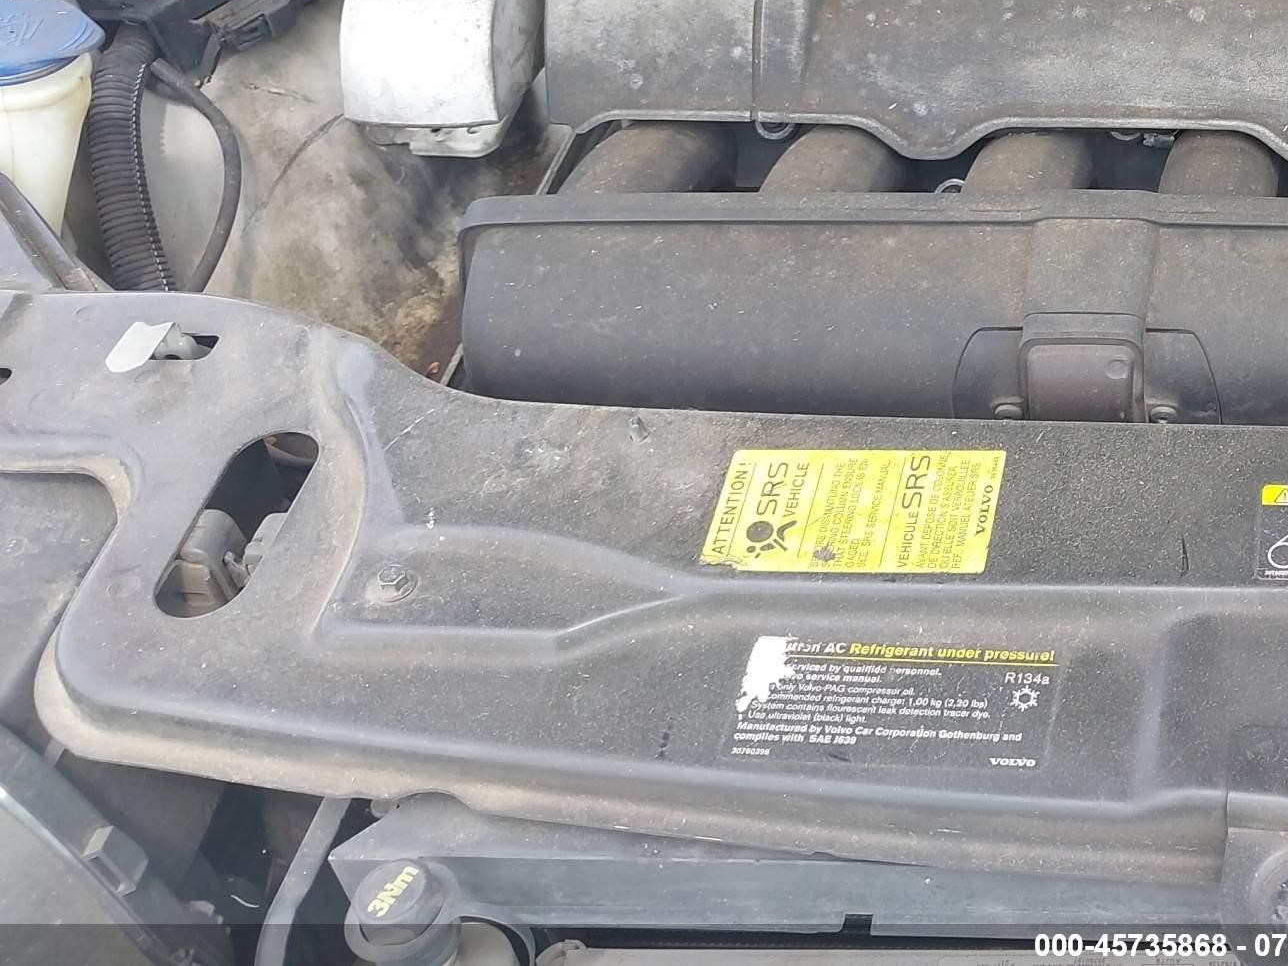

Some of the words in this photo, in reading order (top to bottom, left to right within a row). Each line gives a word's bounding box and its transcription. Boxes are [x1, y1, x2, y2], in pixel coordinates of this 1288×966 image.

[833, 461, 847, 478] THE
[756, 462, 789, 516] SRS
[783, 462, 810, 518] VEHICLE
[901, 455, 931, 510] SRS
[975, 484, 994, 536] VOLVO
[840, 504, 857, 545] STEERING
[930, 513, 947, 555] DIRECTION
[897, 512, 919, 568] VEHICULE
[824, 642, 847, 654] AC
[849, 643, 934, 658] Refrigerant
[937, 647, 982, 660] under
[983, 649, 1056, 663] pressure!
[805, 672, 841, 682] service
[842, 674, 884, 684] manual.
[829, 663, 843, 674] by
[1003, 671, 1051, 685] R134a
[776, 683, 797, 694] only
[799, 684, 846, 695] Volvo-PAG
[847, 687, 902, 698] compressor
[902, 688, 916, 697] oil.
[750, 700, 785, 712] System
[786, 702, 825, 713] contains
[826, 703, 877, 714] flourescent
[878, 705, 898, 715] leak
[899, 706, 942, 717] detection
[943, 708, 970, 718] tracer
[971, 710, 991, 721] dye.
[822, 695, 870, 706] refrigerant
[930, 697, 943, 708] kg
[971, 699, 989, 710] lbs)
[748, 710, 766, 720] Use
[768, 711, 812, 722] ultraviolet
[813, 712, 844, 723] (black)
[845, 713, 868, 724] light.
[733, 732, 780, 743] complies
[782, 732, 805, 743] with
[808, 734, 832, 744] SAE
[832, 734, 858, 745] J639
[736, 721, 808, 733] Manufactured
[809, 723, 824, 735] by
[824, 724, 854, 735] Volvo
[854, 726, 874, 736] Car
[874, 727, 937, 739] Corporation
[938, 729, 1001, 743] Gothenburg
[1002, 732, 1023, 742] and
[988, 757, 1037, 768] VOLVO
[367, 865, 421, 919] 3Nm
